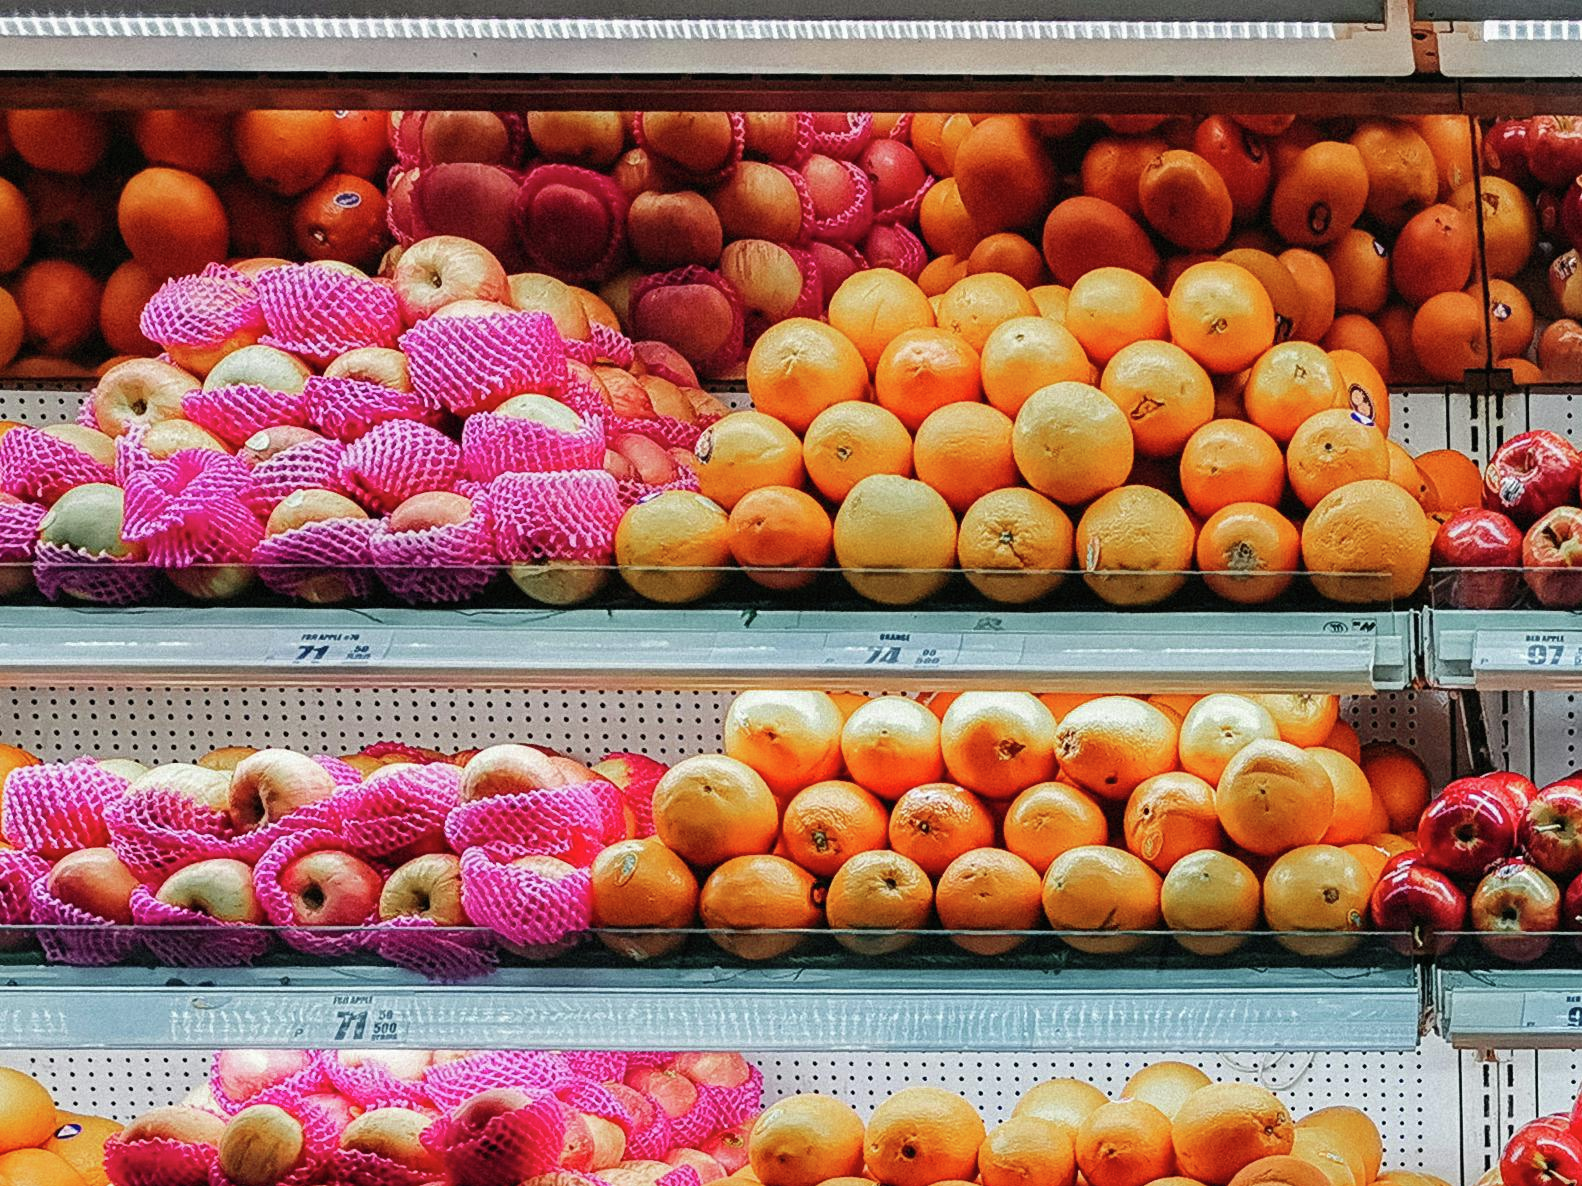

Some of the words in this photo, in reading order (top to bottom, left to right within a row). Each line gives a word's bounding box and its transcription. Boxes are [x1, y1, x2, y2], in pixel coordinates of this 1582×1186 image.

[880, 633, 910, 641] ORANGE
[295, 645, 330, 661] 71
[865, 646, 901, 664] 74
[1527, 644, 1565, 665] 97
[350, 996, 373, 1004] APPLE
[334, 1011, 368, 1040] 71
[373, 1022, 397, 1033] 500
